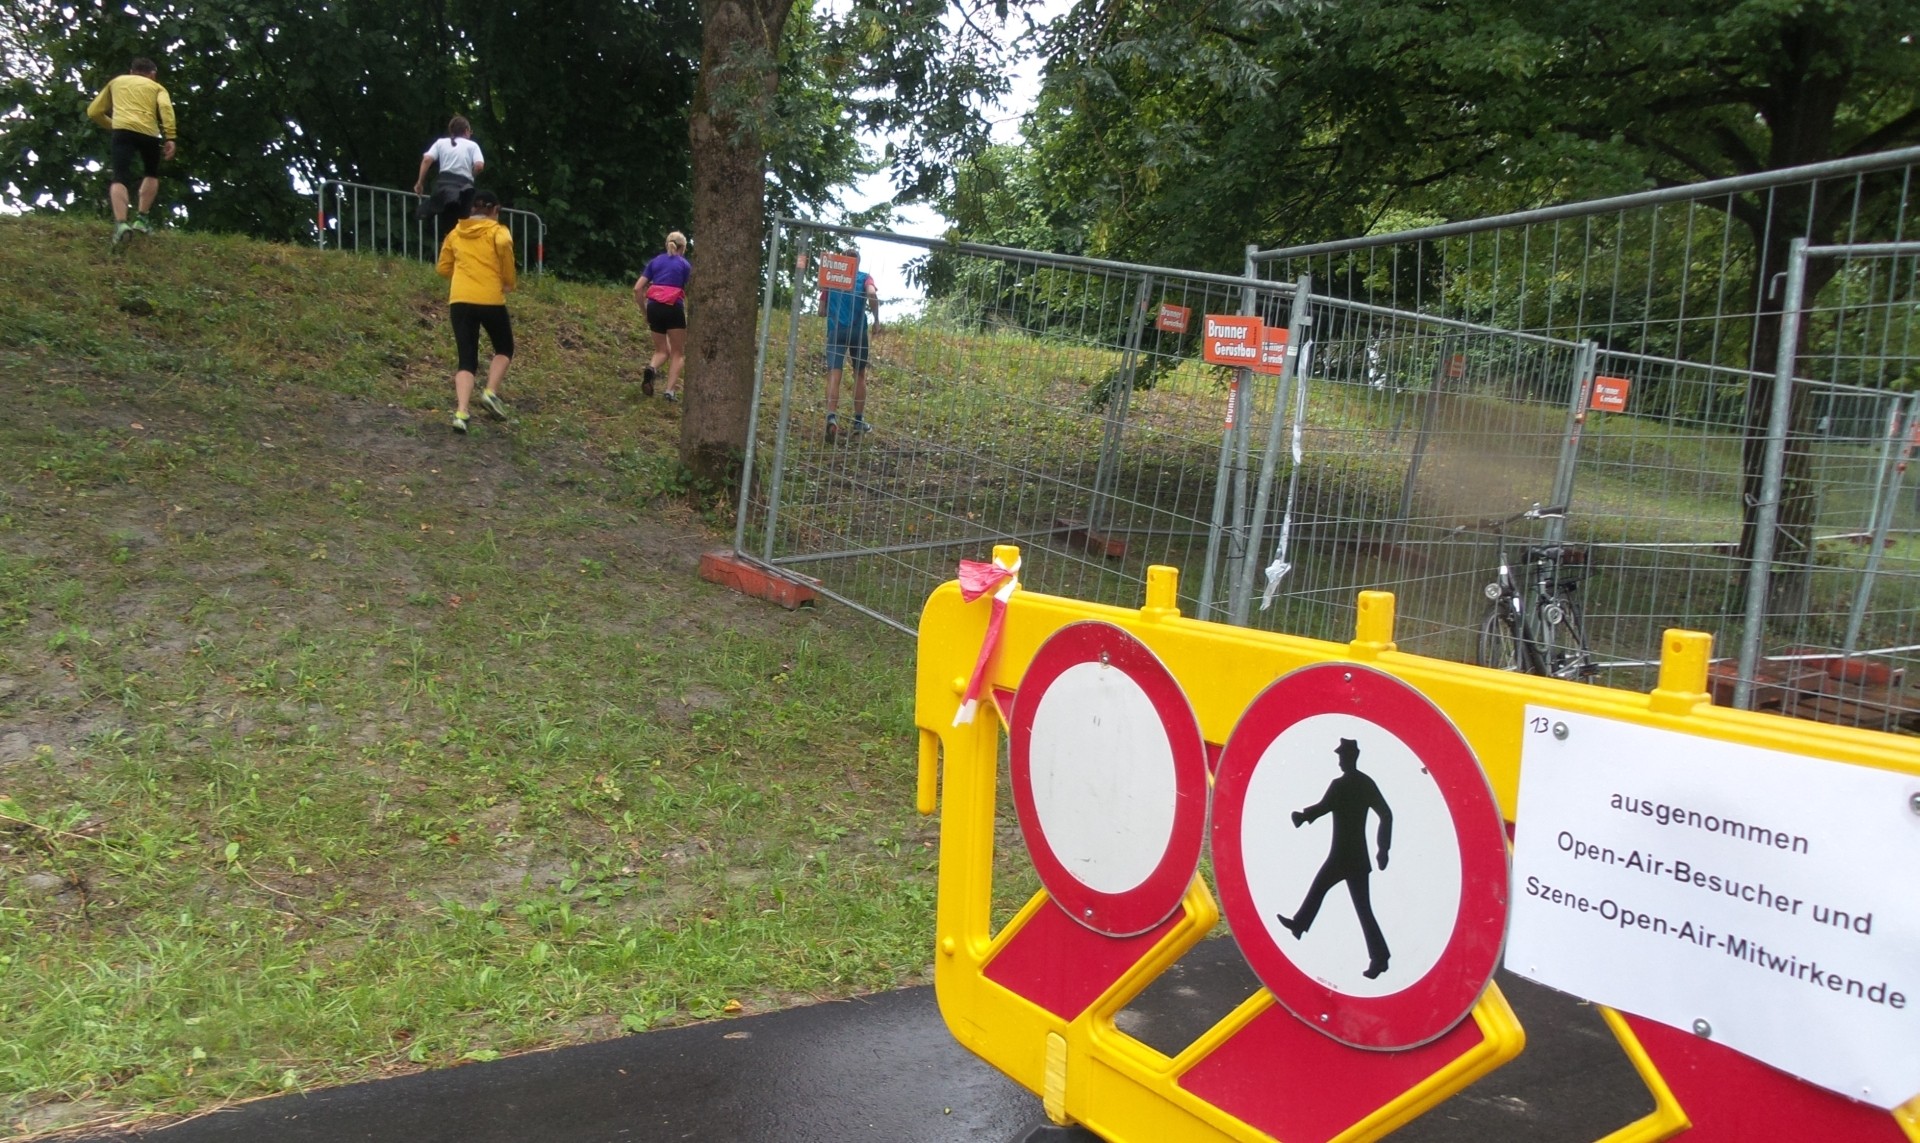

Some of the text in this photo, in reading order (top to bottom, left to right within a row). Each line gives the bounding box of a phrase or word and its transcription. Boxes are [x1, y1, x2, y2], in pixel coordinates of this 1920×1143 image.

[1208, 319, 1248, 339] Brunner
[1214, 341, 1257, 358] Gerüstbau
[1225, 389, 1237, 423] Brunner
[1529, 716, 1549, 734] 13
[1610, 792, 1809, 855] ausgenommen
[1557, 830, 1874, 936] Open-Air-Besucher und
[1525, 875, 1908, 1010] Szene-Open-Air-Mitwirkende
